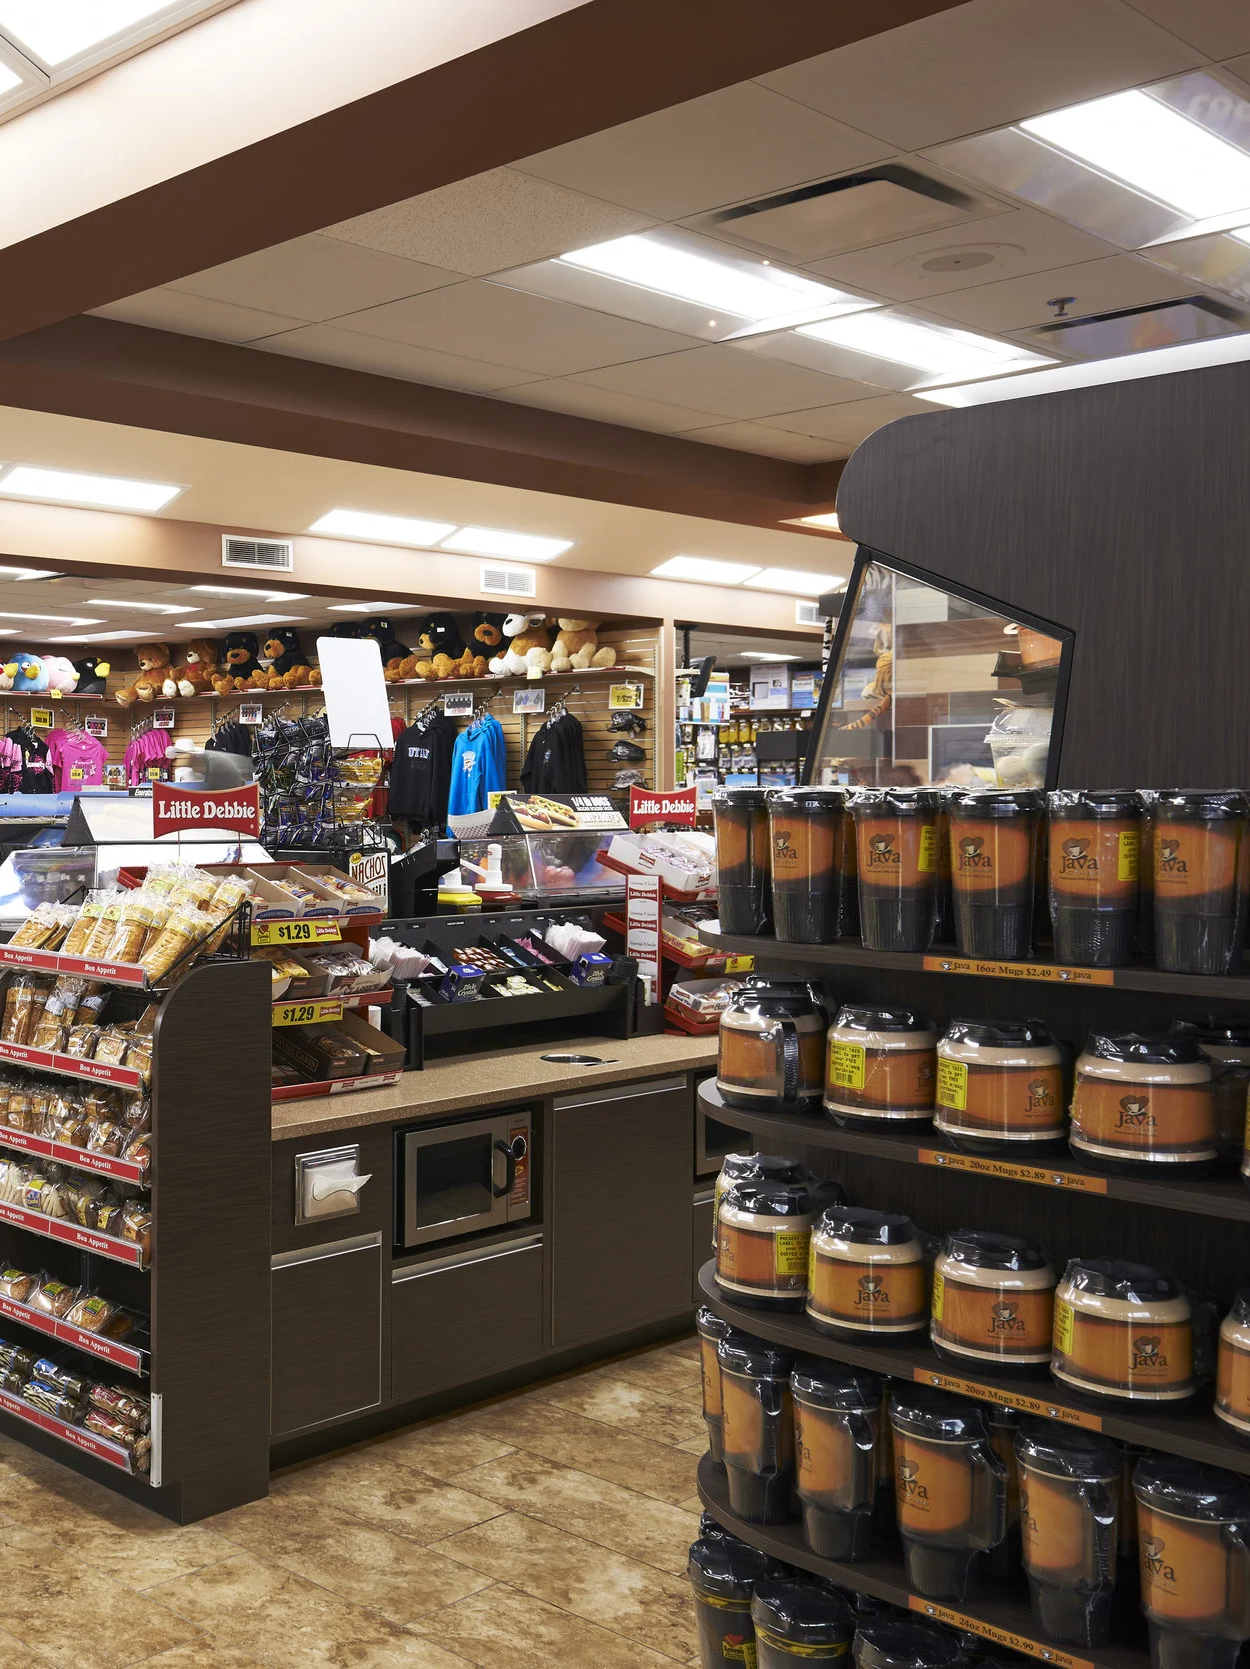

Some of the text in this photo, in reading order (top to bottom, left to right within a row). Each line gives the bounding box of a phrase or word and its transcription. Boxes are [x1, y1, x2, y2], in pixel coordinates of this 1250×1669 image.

[158, 800, 256, 819] Little Debbie
[633, 799, 695, 814] Little Debbie
[867, 851, 903, 867] Java
[957, 855, 992, 871] Java
[1058, 856, 1100, 874] Java
[1157, 857, 1188, 873] ava
[351, 855, 386, 884] NACHOS
[278, 923, 311, 941] $1.29
[14, 953, 33, 962] Appetit
[84, 963, 117, 976] Bon Appetit
[975, 964, 996, 974] 16oz
[998, 965, 1025, 978] Mugs
[1026, 967, 1052, 978] $2.49
[283, 1005, 314, 1022] $1.29
[0, 1046, 28, 1059] Bon Appetit
[80, 1064, 111, 1077] Bon Appetit
[914, 1075, 936, 1092] Jav
[1114, 1111, 1158, 1128] Java
[8, 1134, 27, 1145] Appetit
[79, 1154, 111, 1169] Bon Appetit
[969, 1160, 990, 1172] 20oz
[993, 1164, 1018, 1178] Mugs
[1020, 1168, 1045, 1181] $2.89
[6, 1209, 25, 1221] Appetit
[77, 1233, 109, 1250] Bon Appetit
[854, 1289, 889, 1305] Java
[2, 1302, 31, 1320] Bon Appetit
[987, 1316, 1026, 1332] Java
[78, 1334, 111, 1354] Bon Appetit
[1129, 1352, 1168, 1370] Java
[2, 1396, 21, 1412] Appetit
[965, 1383, 986, 1398] 20oz
[987, 1390, 1014, 1405] Mugs
[1015, 1396, 1041, 1411] $2.89
[65, 1429, 96, 1450] Bon Appetit
[959, 1617, 980, 1632] 24oz
[981, 1625, 1009, 1643] Mugs
[1009, 1635, 1034, 1651] $2.99
